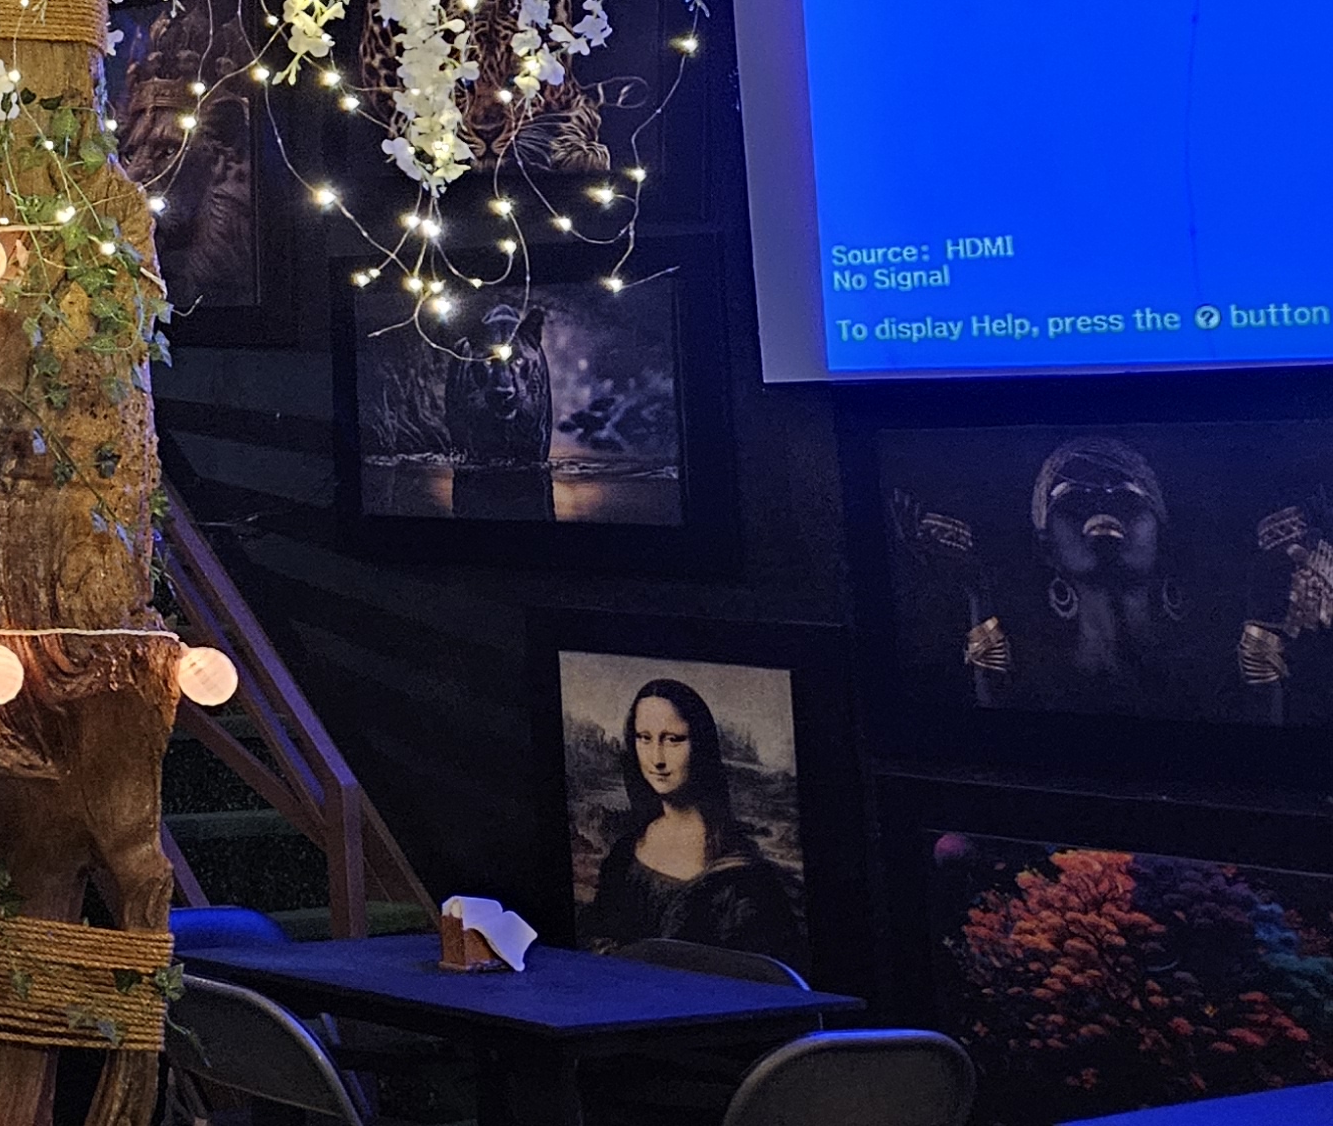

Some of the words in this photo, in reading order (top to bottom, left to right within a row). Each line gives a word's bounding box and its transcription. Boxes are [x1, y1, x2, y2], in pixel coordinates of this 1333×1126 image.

[831, 240, 931, 266] Source:
[945, 235, 1015, 259] HDMI
[833, 269, 867, 292] No
[873, 265, 951, 291] Signal
[836, 319, 867, 341] To
[874, 315, 962, 343] display
[971, 314, 1040, 340] Help,
[1048, 312, 1121, 337] press
[1132, 307, 1181, 332] the
[1230, 302, 1330, 329] button
